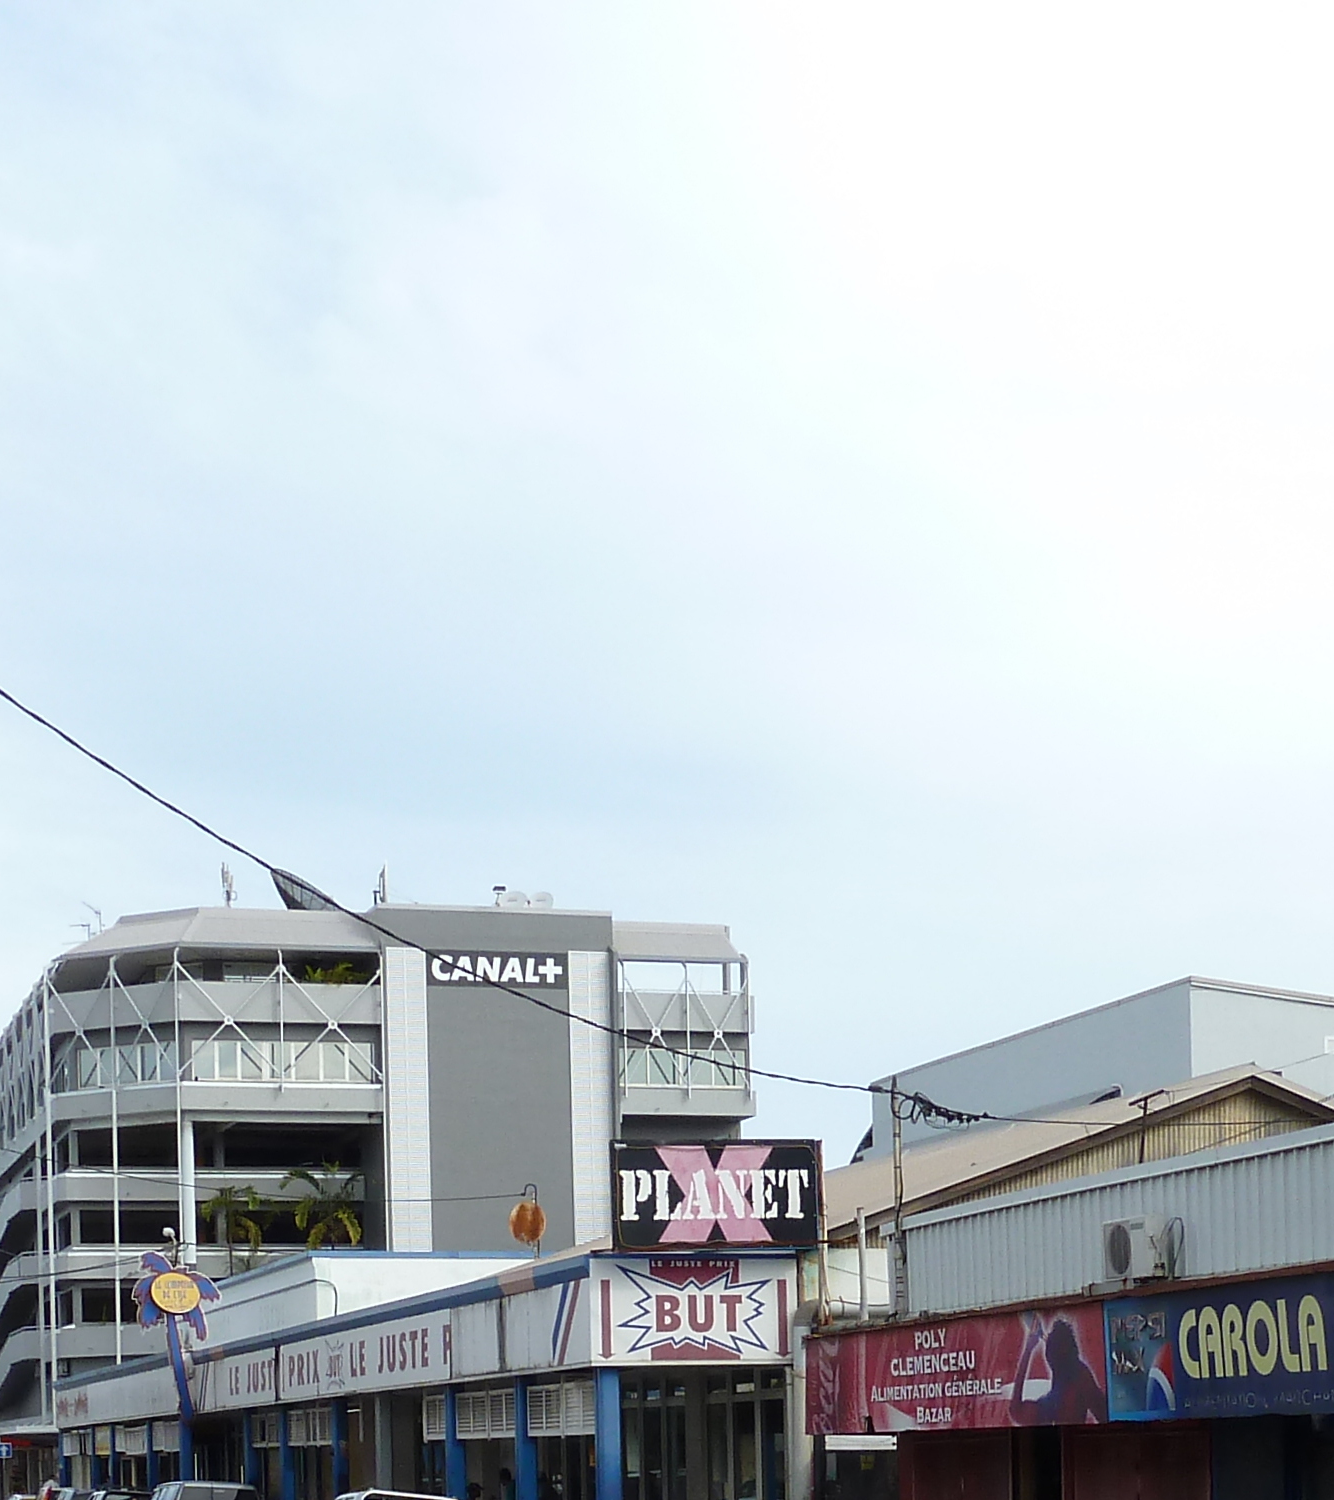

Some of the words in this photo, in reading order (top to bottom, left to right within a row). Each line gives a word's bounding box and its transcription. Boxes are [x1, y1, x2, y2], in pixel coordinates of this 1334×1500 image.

[431, 954, 563, 984] CANAL+
[619, 1169, 809, 1221] PLANET
[655, 1295, 743, 1333] BUT
[349, 1340, 366, 1378] LE
[378, 1328, 429, 1374] JUSTE
[914, 1328, 946, 1350] POLY
[1179, 1295, 1328, 1379] CAROLA
[229, 1366, 240, 1396] LE
[247, 1356, 284, 1394] JUST
[288, 1349, 320, 1388] PRIX
[890, 1350, 975, 1377] CLEMENCEAU
